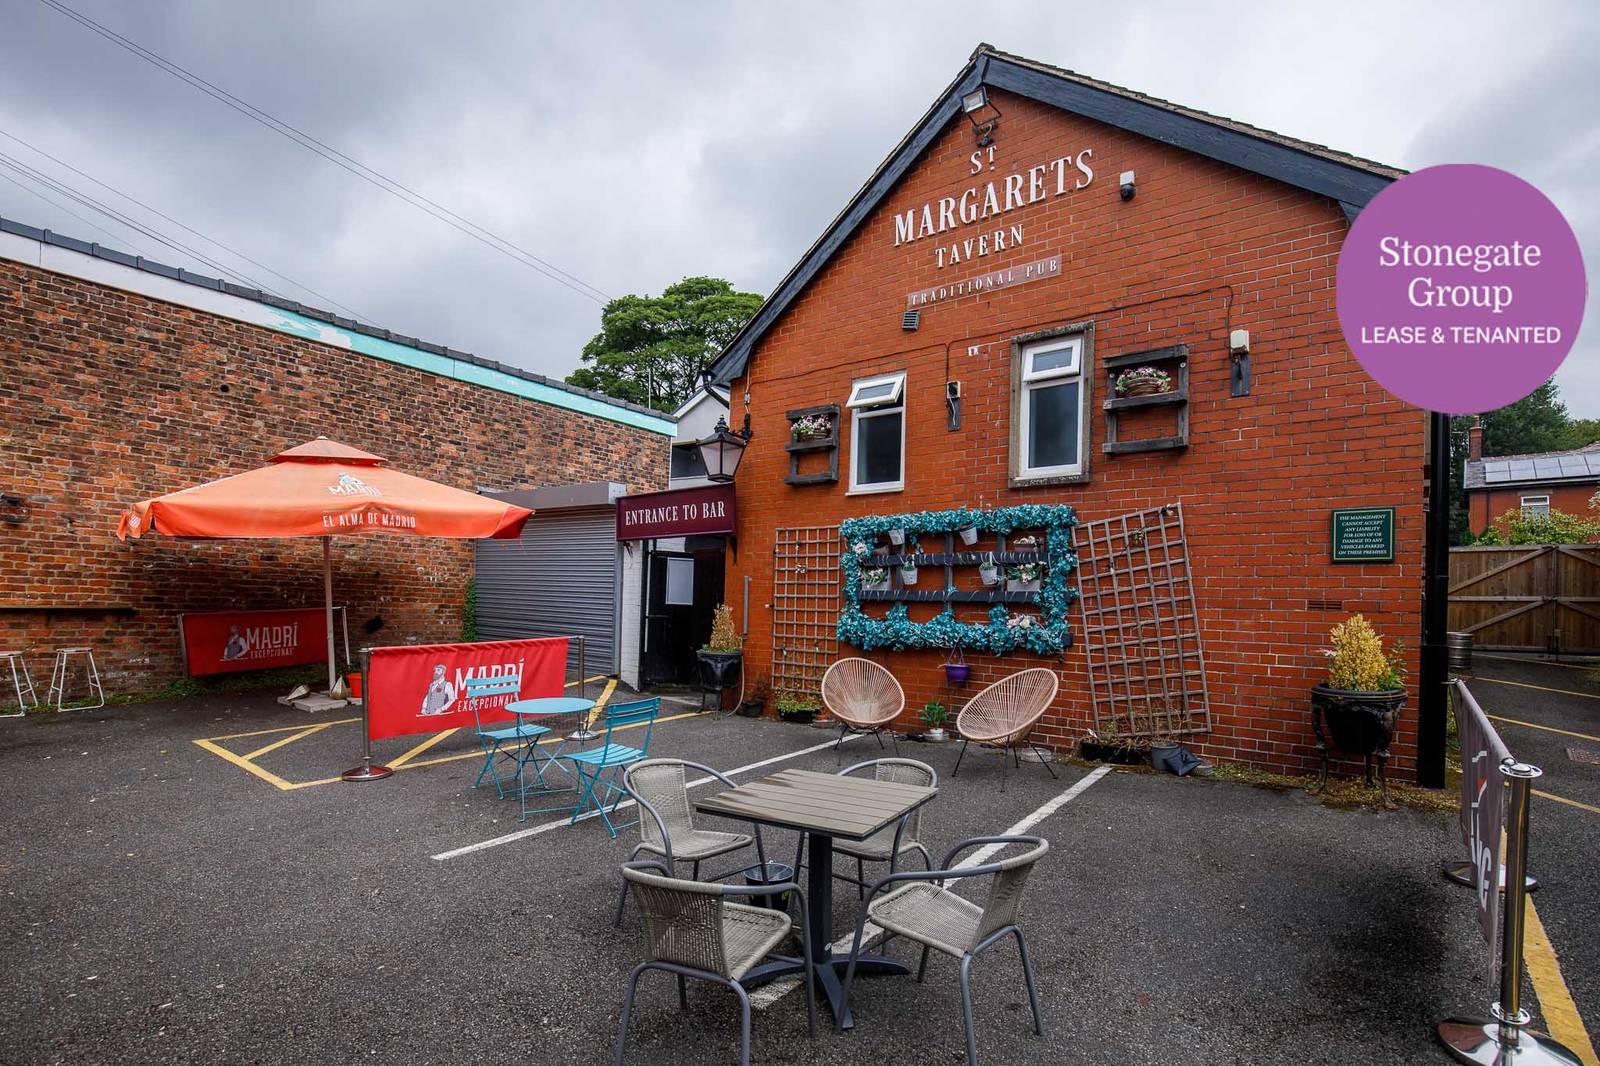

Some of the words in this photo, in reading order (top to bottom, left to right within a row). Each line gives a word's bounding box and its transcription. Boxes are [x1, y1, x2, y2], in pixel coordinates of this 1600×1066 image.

[893, 148, 1094, 247] MARGARETS
[935, 224, 1023, 269] TAVERN
[911, 271, 1014, 305] TRADITIONAL
[1026, 259, 1058, 278] PUB
[323, 515, 336, 527] EL
[339, 513, 364, 526] ALMA
[367, 512, 378, 525] DE
[382, 513, 416, 528] MADRID
[625, 506, 678, 526] ENTRANCE
[683, 504, 697, 520] TO
[702, 501, 725, 519] BAR
[246, 622, 298, 650] MADRÍ
